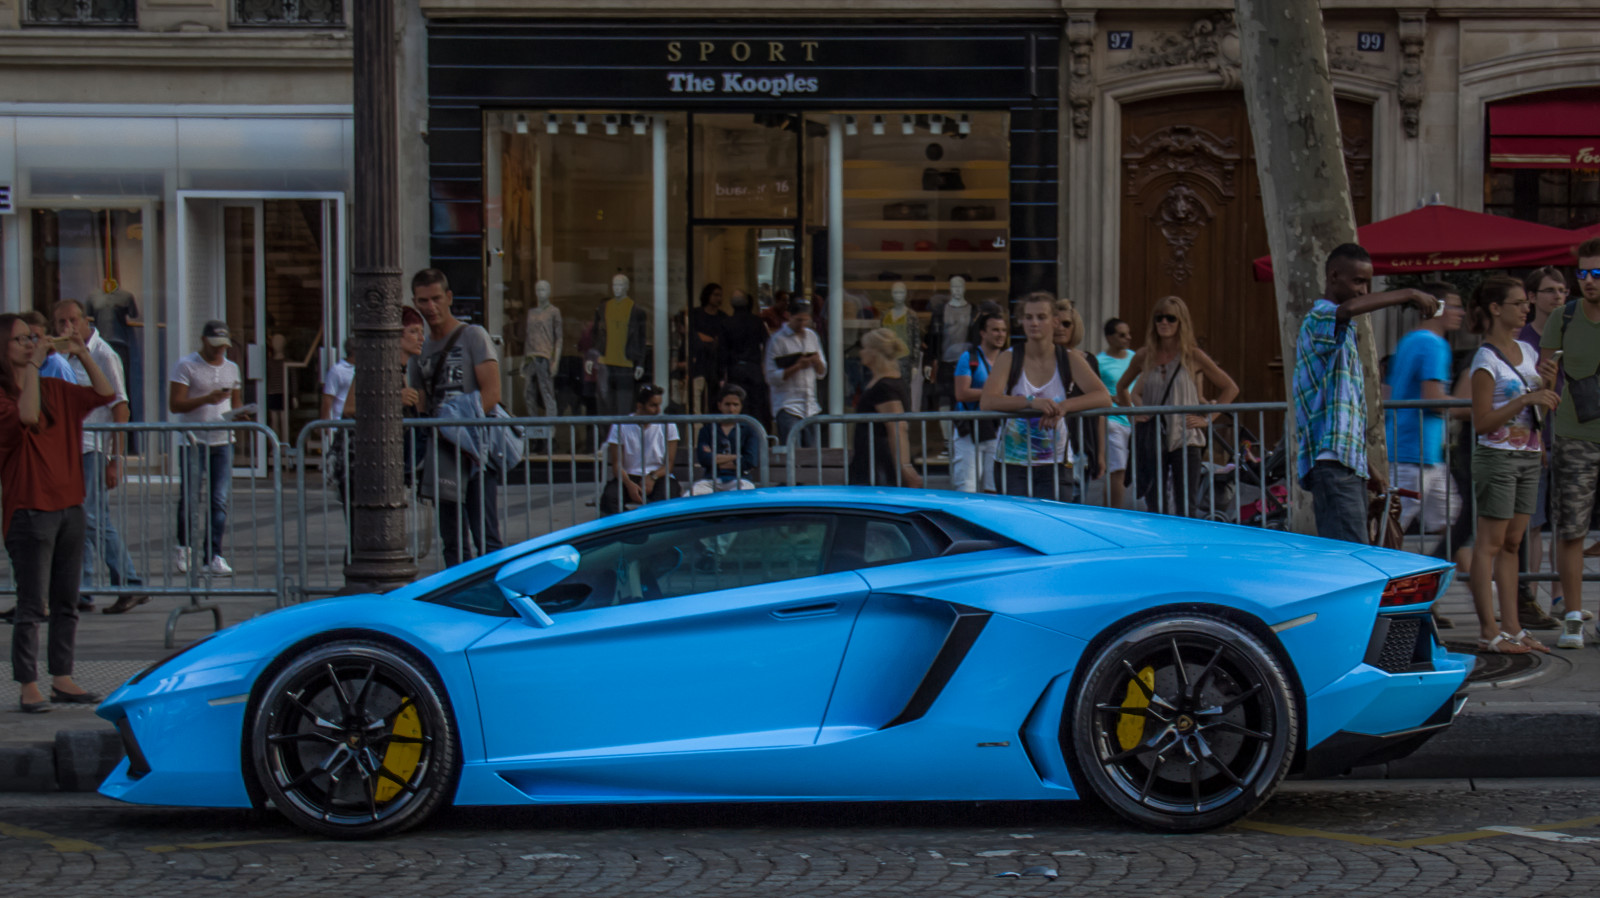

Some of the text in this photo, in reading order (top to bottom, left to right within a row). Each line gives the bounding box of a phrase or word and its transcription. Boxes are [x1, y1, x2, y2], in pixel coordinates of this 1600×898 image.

[1111, 33, 1130, 48] 97
[1361, 34, 1381, 49] 99
[667, 41, 819, 61] SPORT
[667, 72, 819, 96] The Kooples
